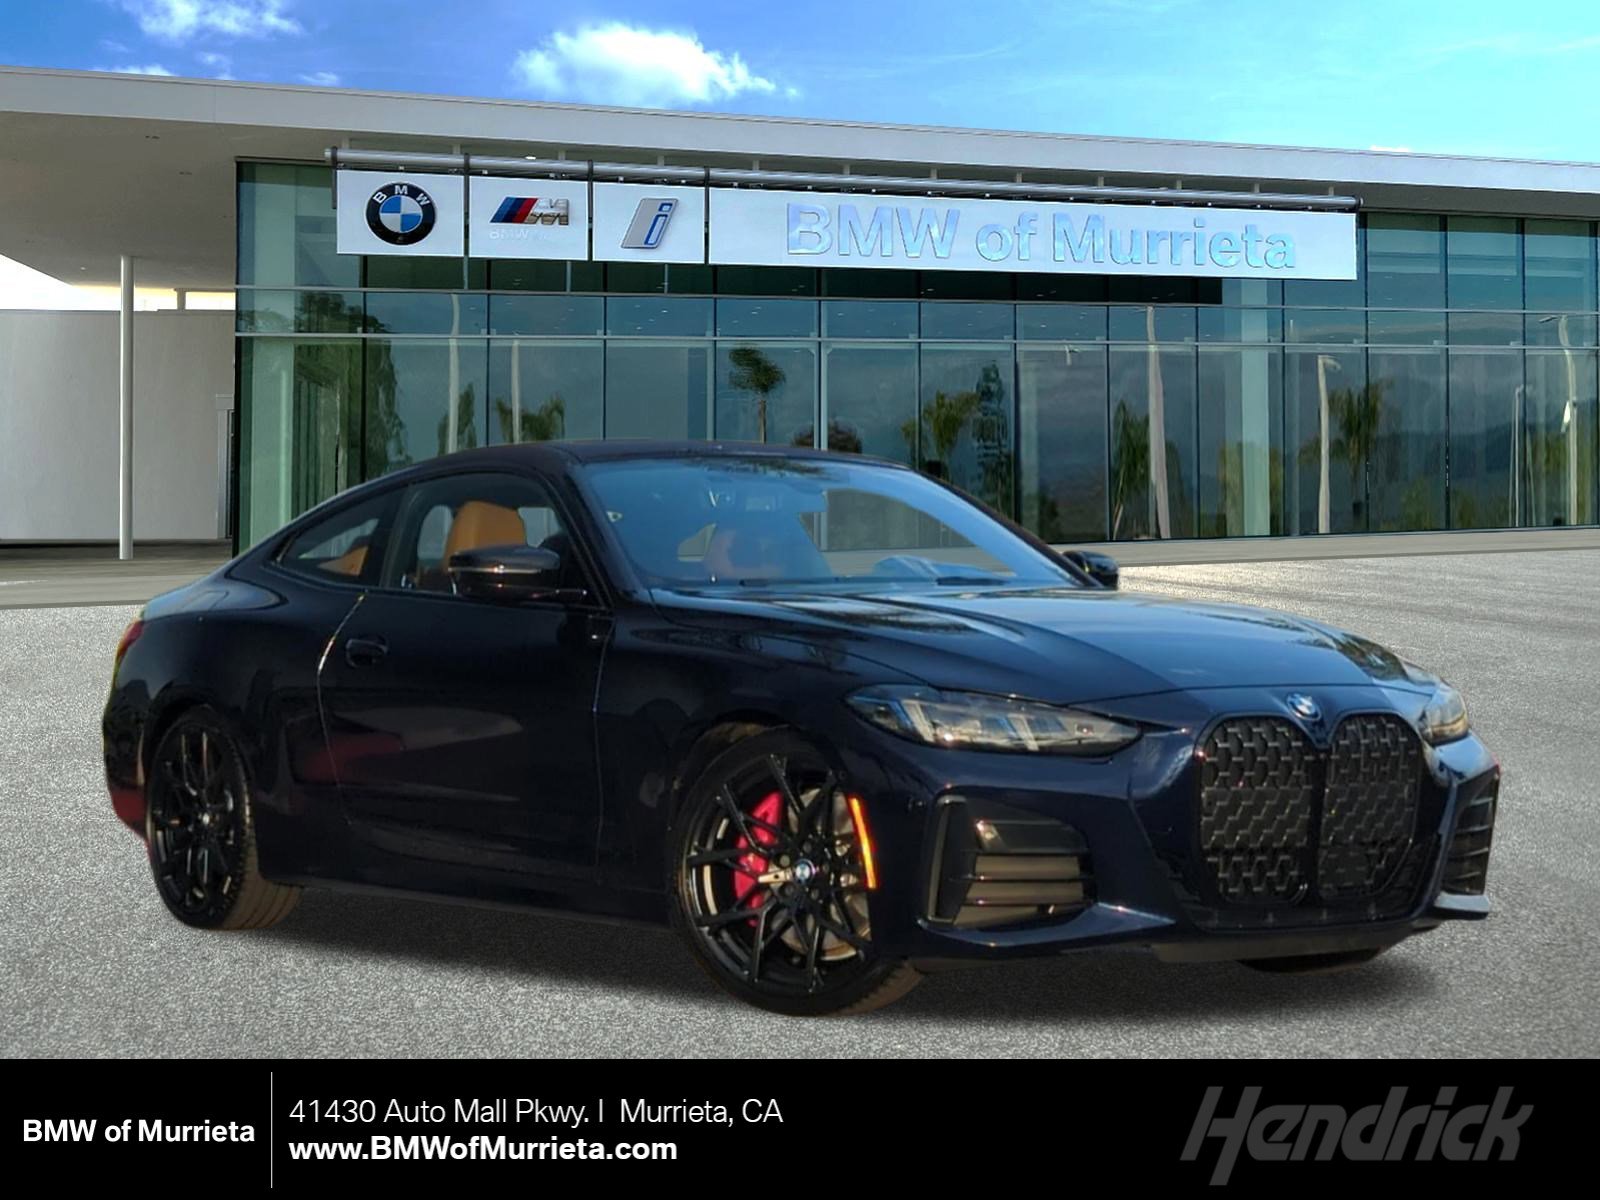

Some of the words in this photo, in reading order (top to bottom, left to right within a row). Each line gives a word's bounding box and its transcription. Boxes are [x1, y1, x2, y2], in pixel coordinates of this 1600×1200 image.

[372, 185, 431, 206] BMW
[786, 203, 960, 259] BMW
[975, 213, 1038, 262] of
[1052, 213, 1296, 269] Murrieta
